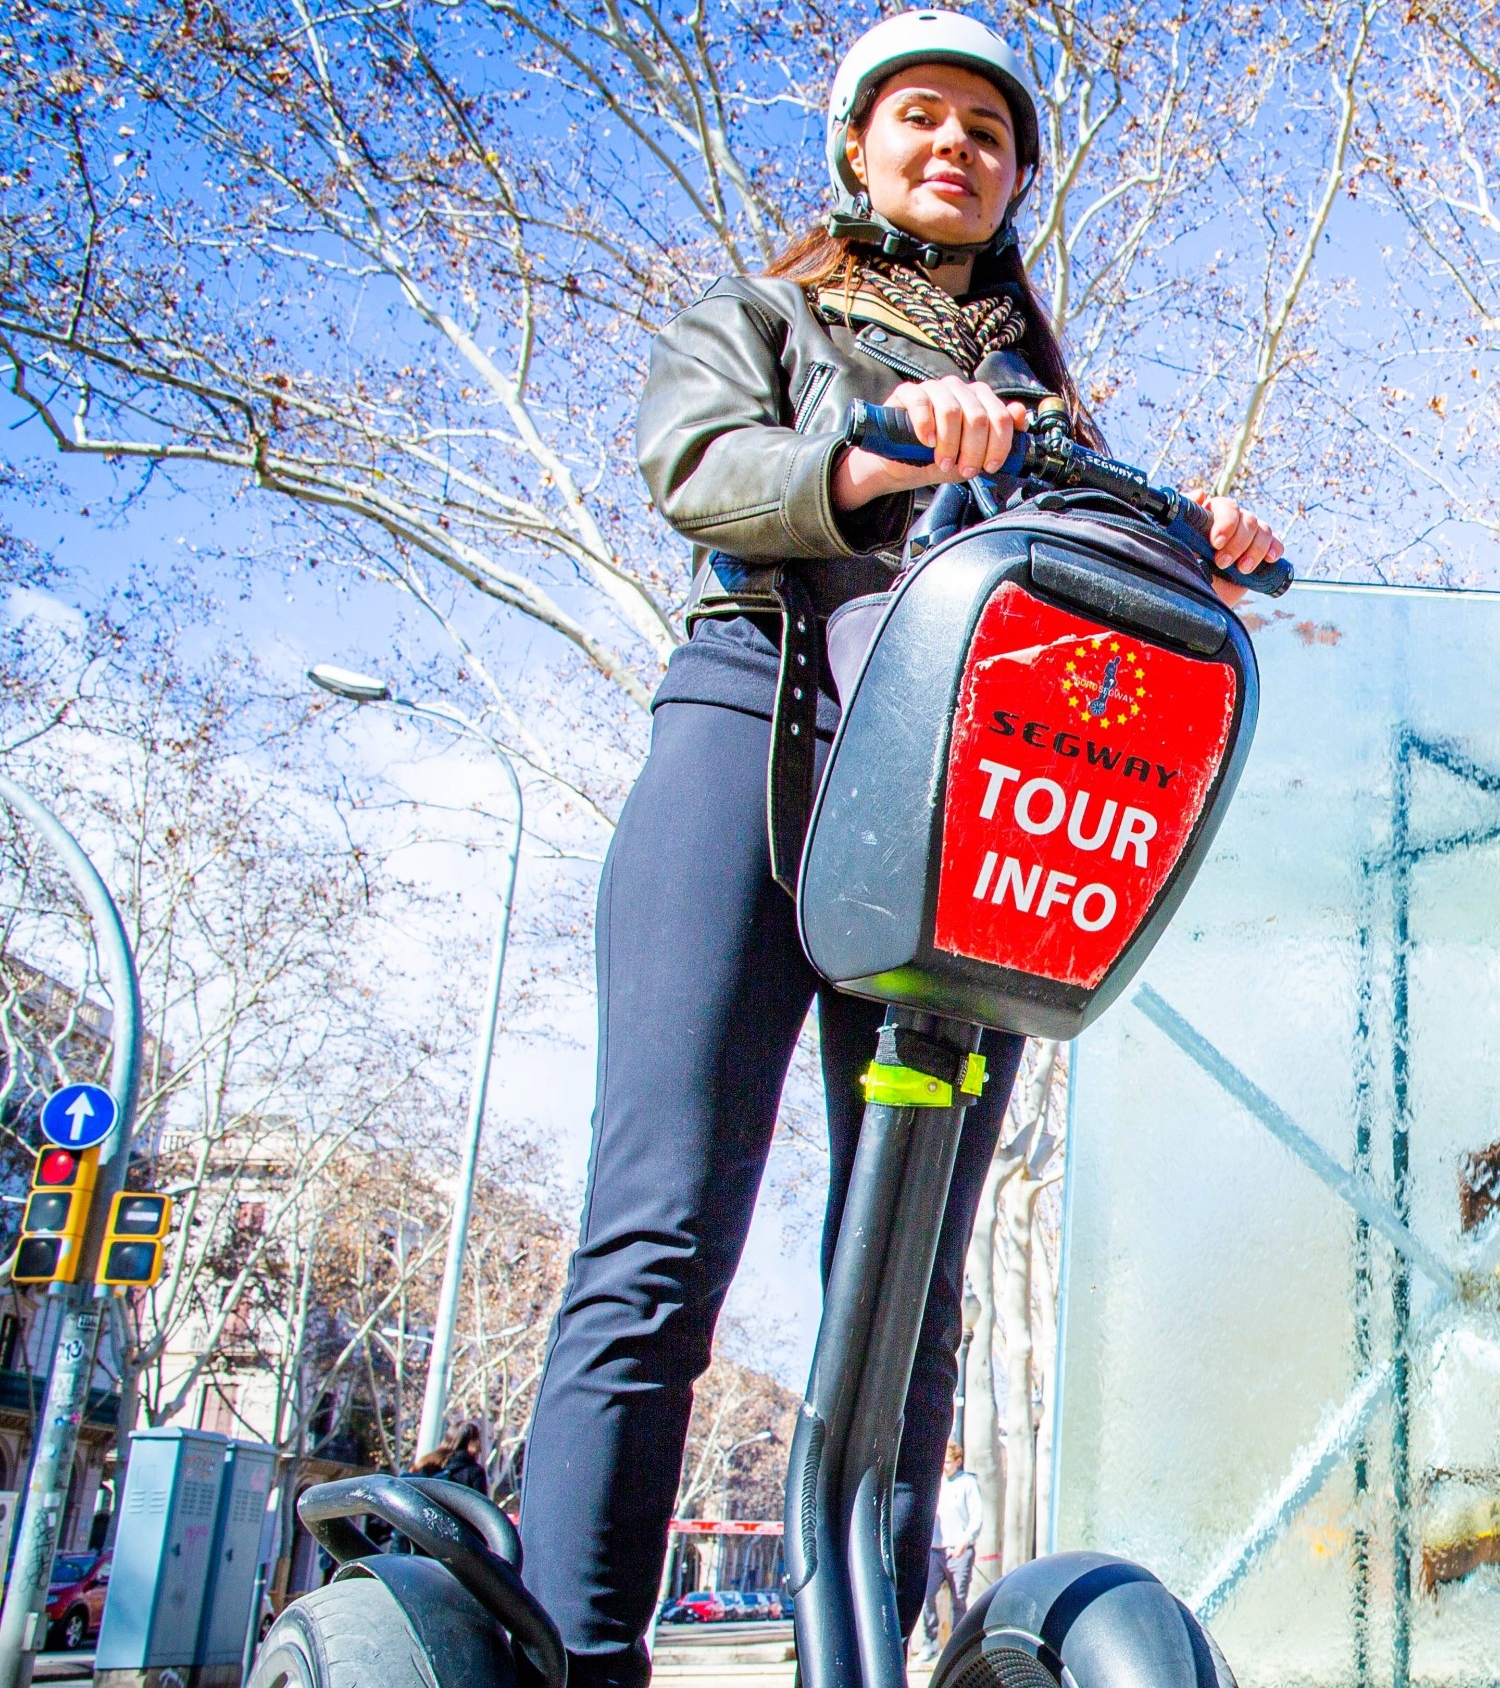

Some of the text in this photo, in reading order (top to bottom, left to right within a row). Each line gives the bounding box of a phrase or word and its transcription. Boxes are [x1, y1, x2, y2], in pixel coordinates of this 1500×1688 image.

[1085, 455, 1134, 479] SEGWAY
[1098, 684, 1135, 704] SEGWAY
[988, 709, 1179, 789] SEGWAY
[978, 757, 1158, 869] TOUR
[972, 850, 1117, 932] INFO
